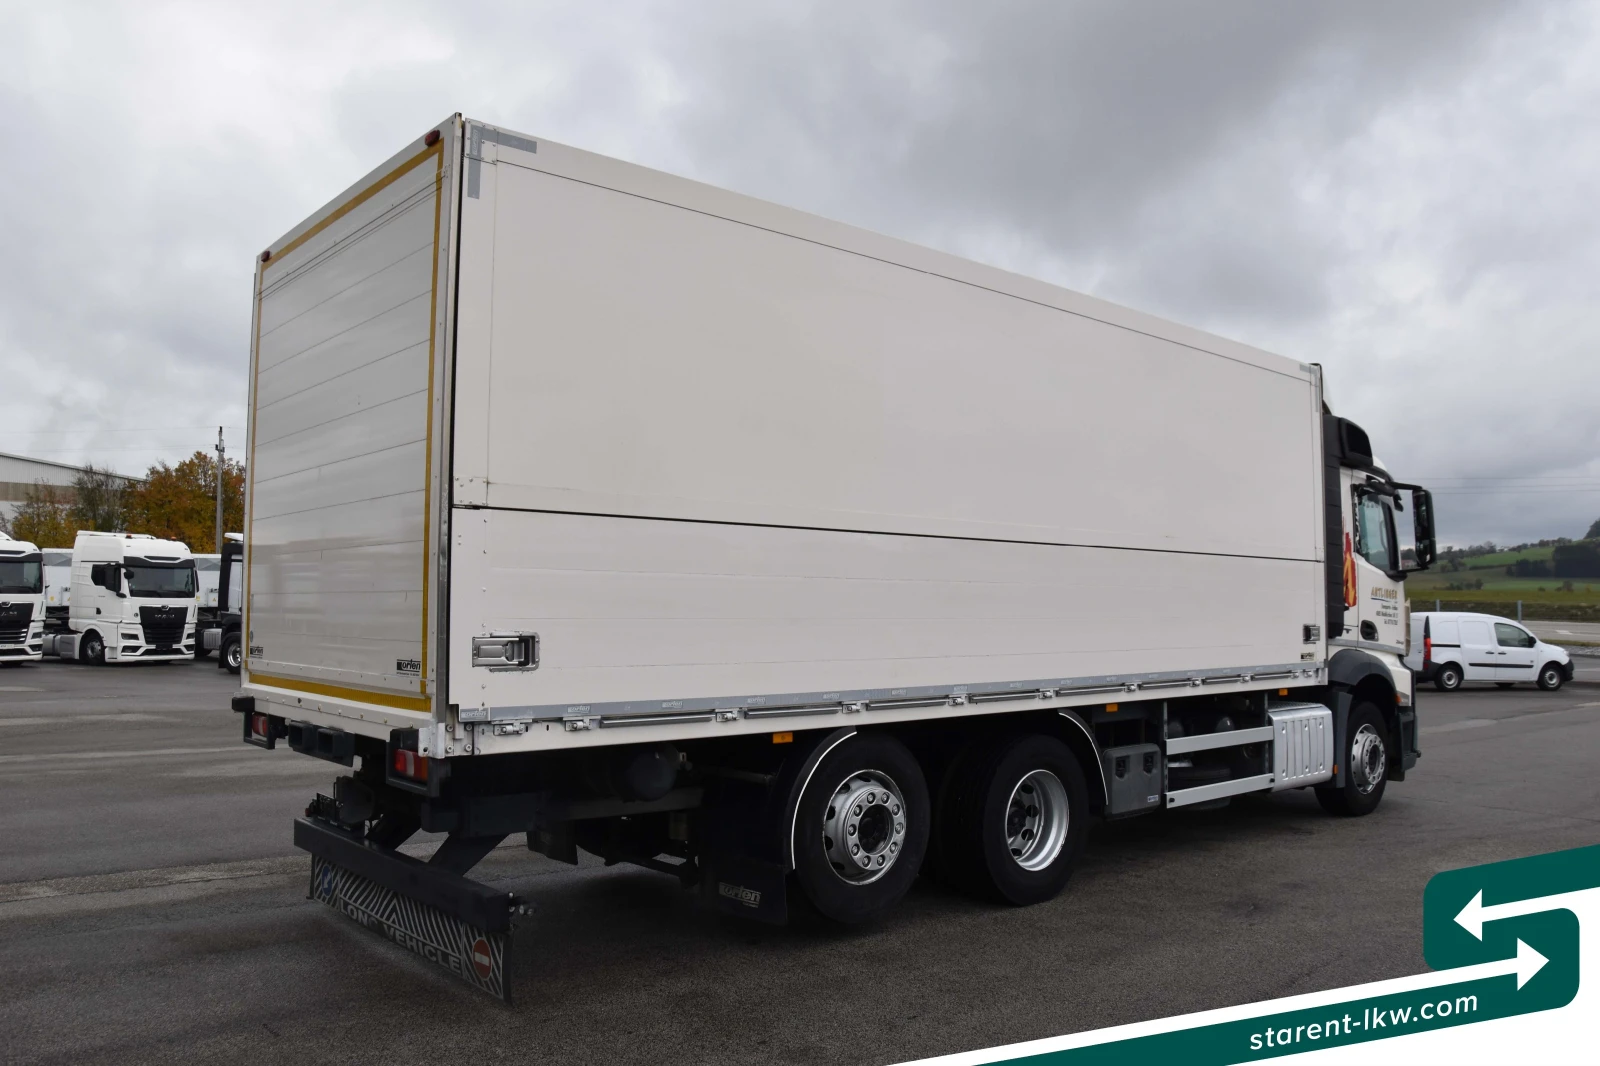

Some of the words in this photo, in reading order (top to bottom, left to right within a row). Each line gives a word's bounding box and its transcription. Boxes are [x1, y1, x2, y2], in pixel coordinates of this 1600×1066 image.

[402, 658, 421, 670] orten
[724, 884, 761, 902] orten
[383, 923, 462, 974] VEHICLE
